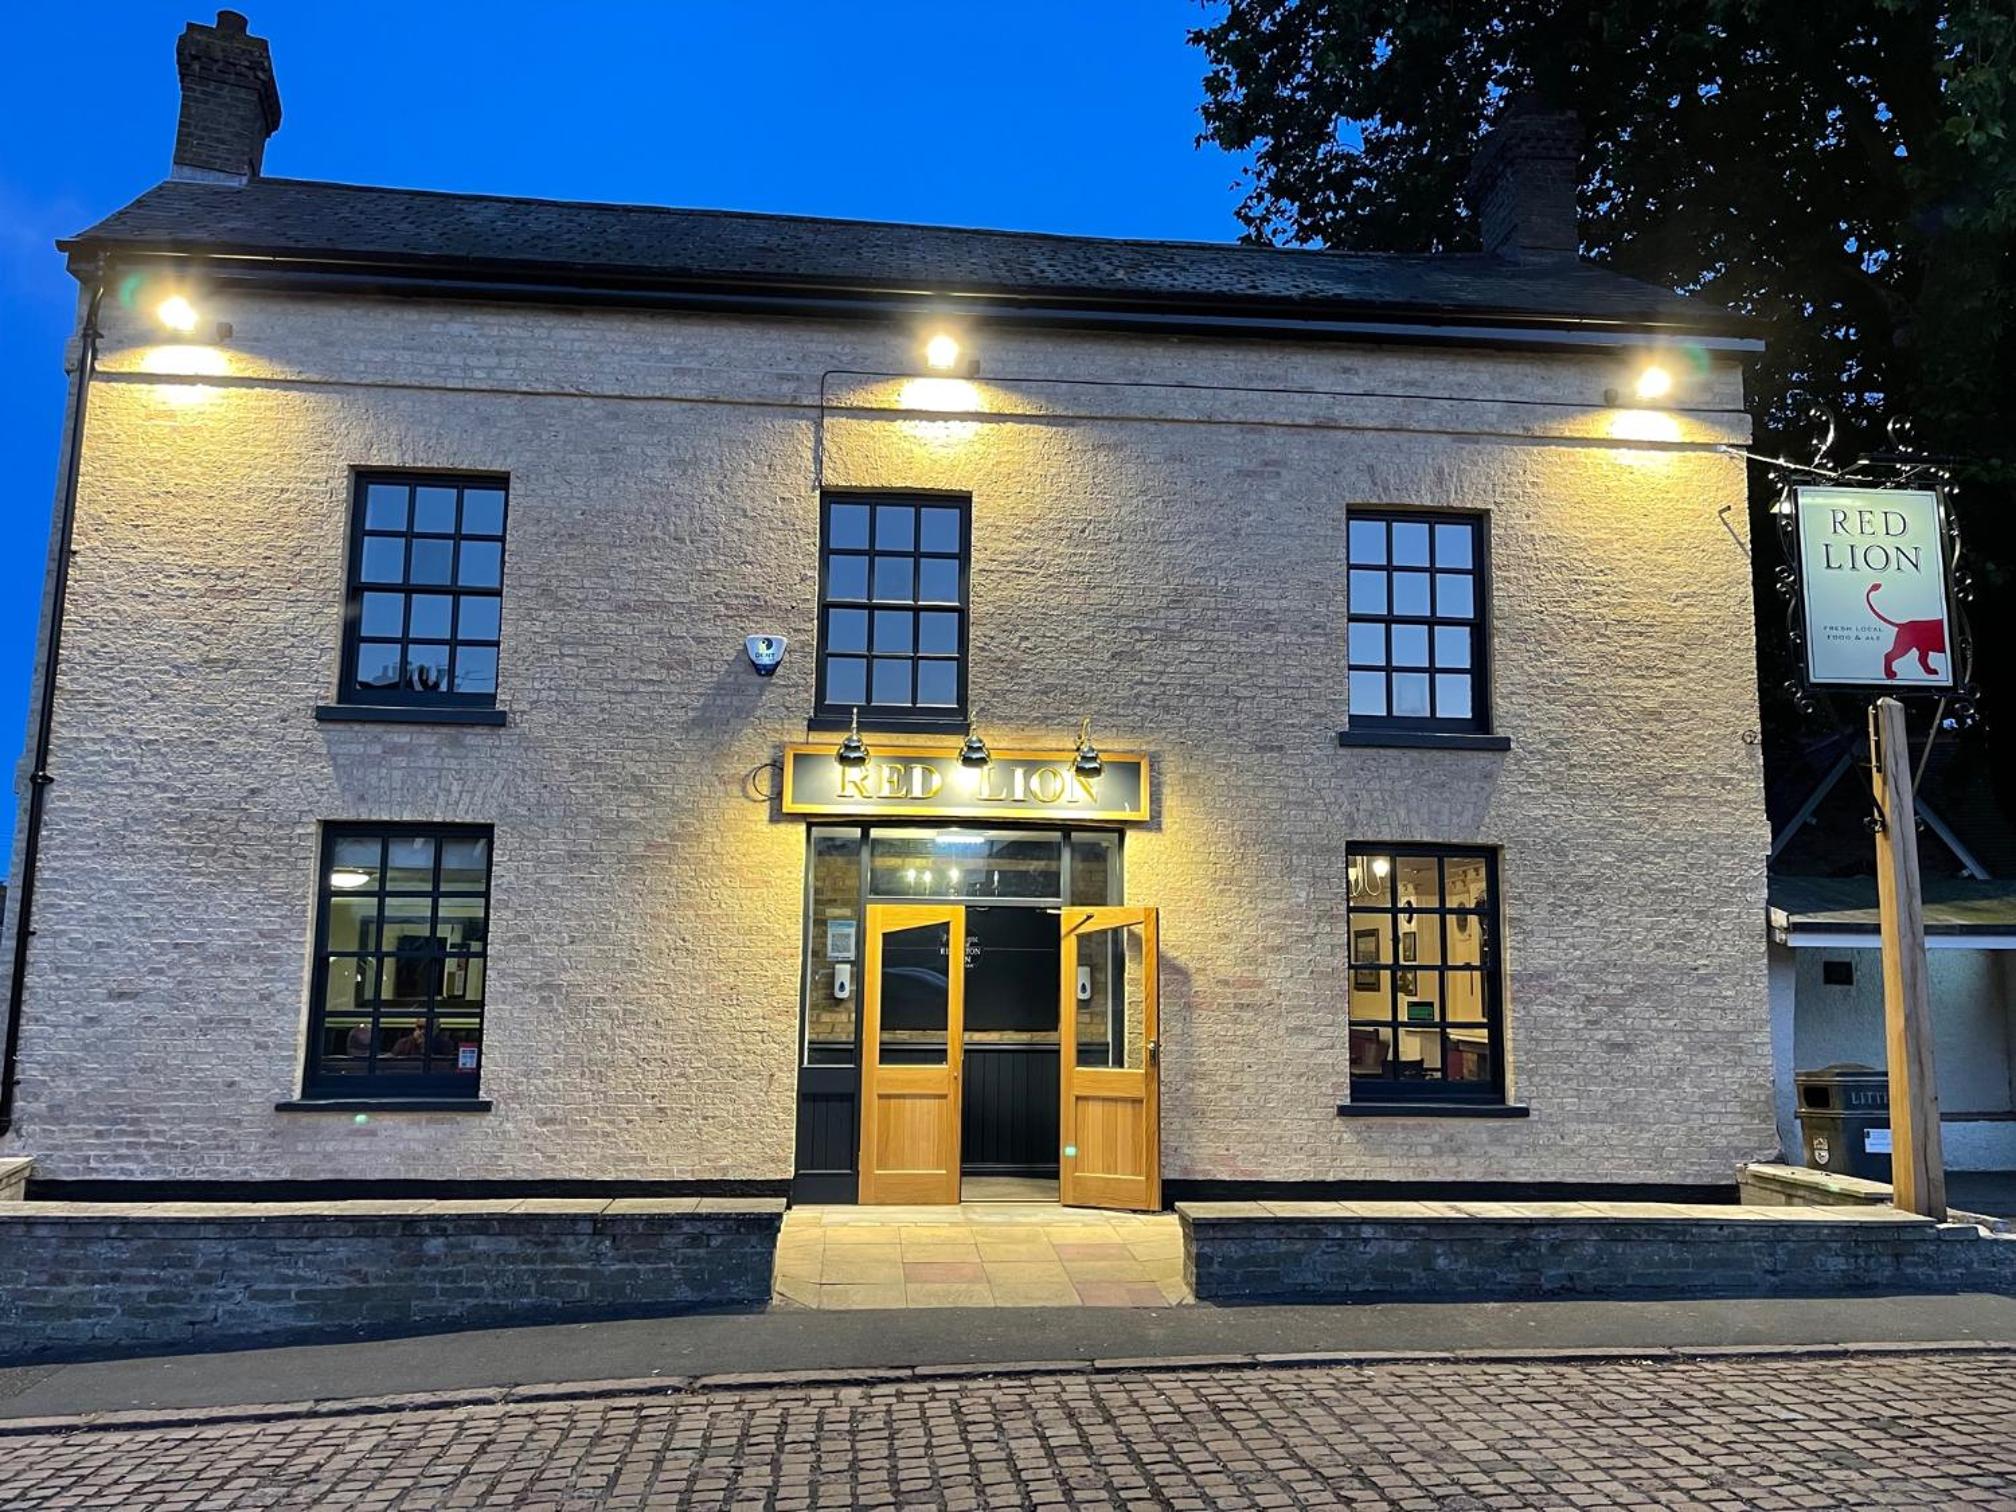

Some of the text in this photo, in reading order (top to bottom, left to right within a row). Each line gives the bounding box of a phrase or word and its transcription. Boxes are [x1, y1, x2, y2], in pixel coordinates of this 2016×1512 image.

[1831, 508, 1909, 538] RED
[1822, 543, 1922, 572] LION
[1855, 625, 1884, 633] LOCAL
[836, 763, 1098, 804] RED LION
